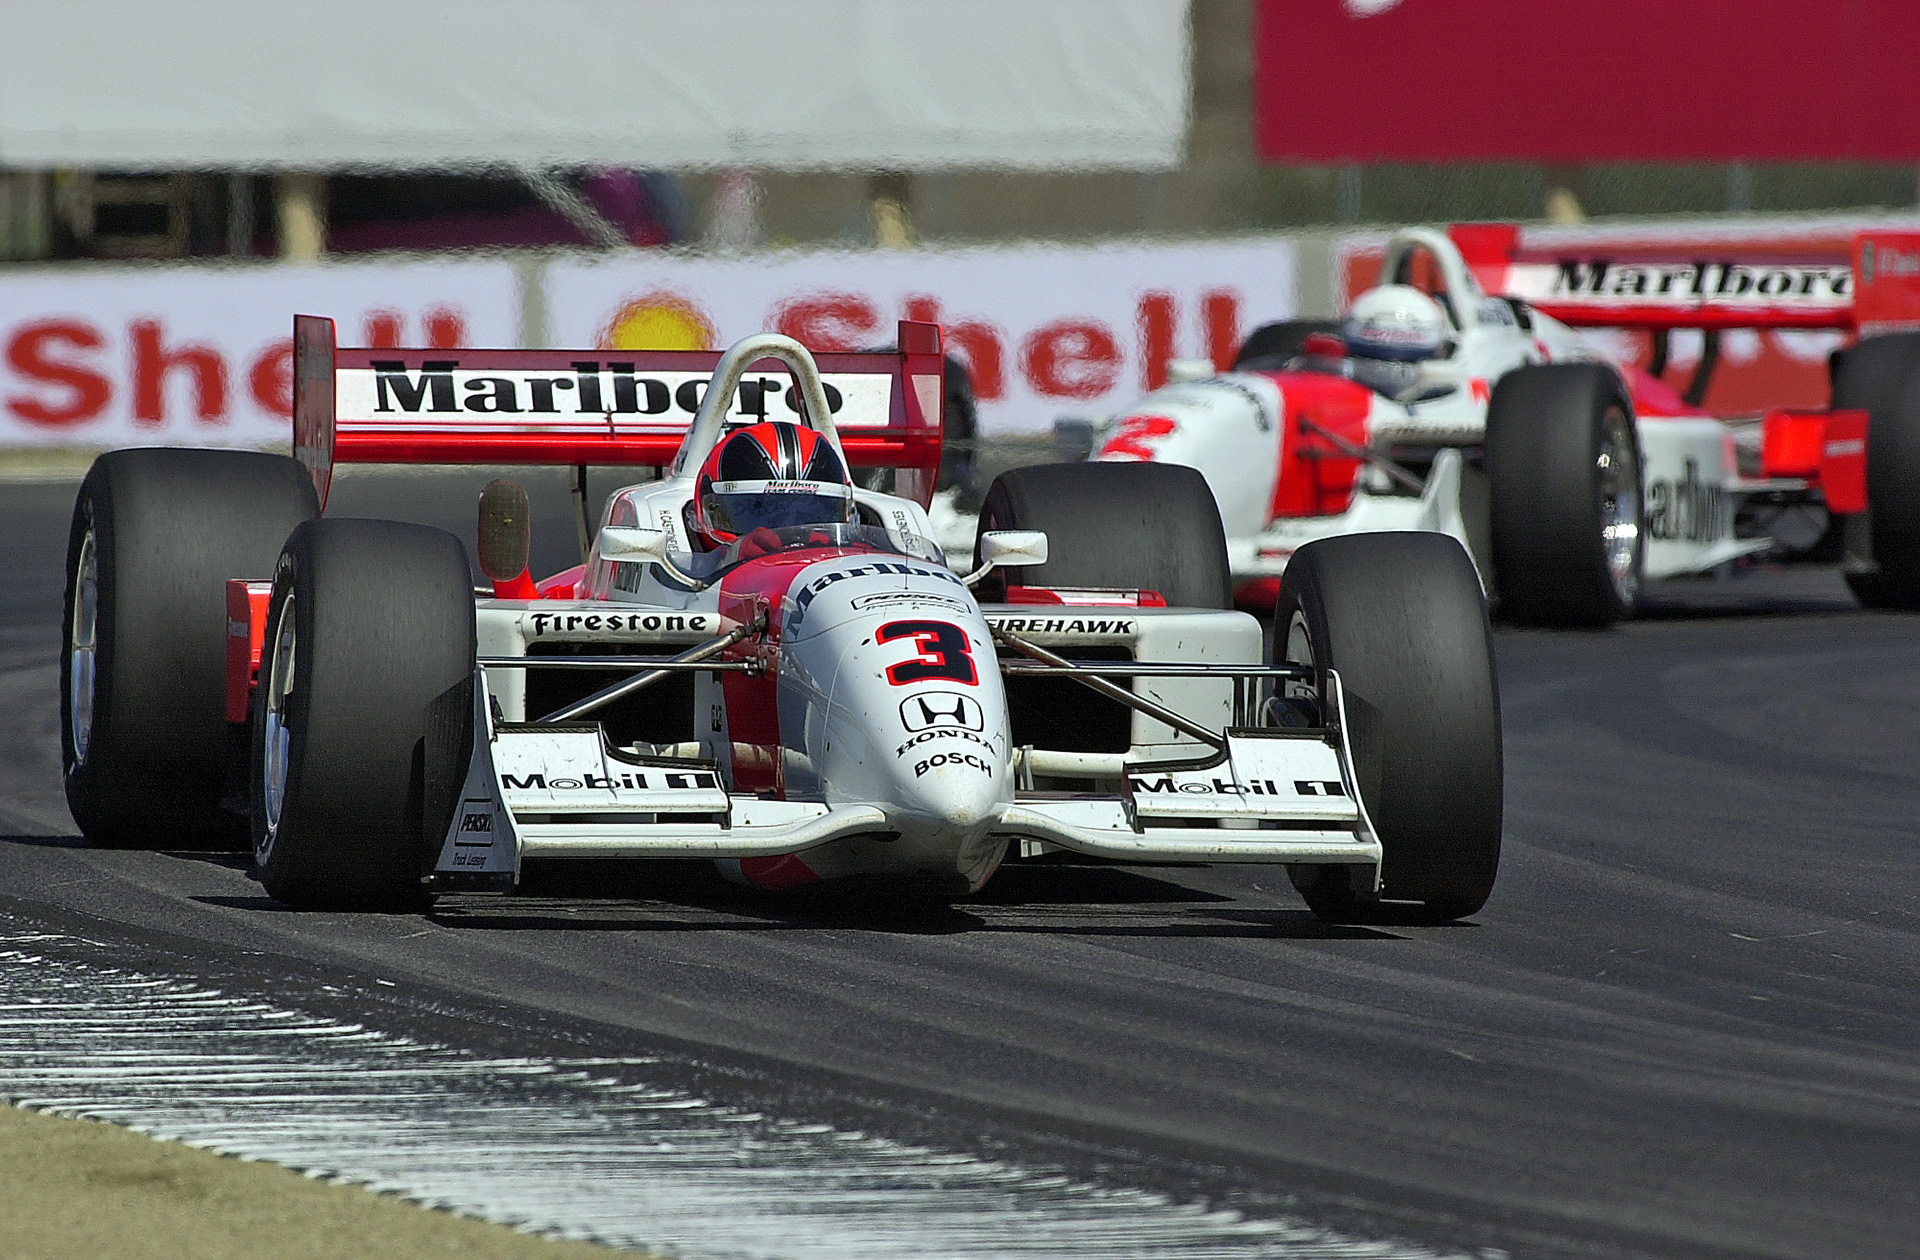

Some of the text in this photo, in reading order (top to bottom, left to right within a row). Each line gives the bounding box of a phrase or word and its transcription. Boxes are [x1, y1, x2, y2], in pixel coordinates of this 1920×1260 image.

[370, 361, 843, 414] Marlboro
[531, 613, 708, 637] Firestone
[875, 620, 979, 686] 3
[896, 729, 998, 759] HONDA
[914, 752, 993, 779] BOSCH
[501, 773, 649, 790] Mobil
[1128, 778, 1279, 795] Mobil
